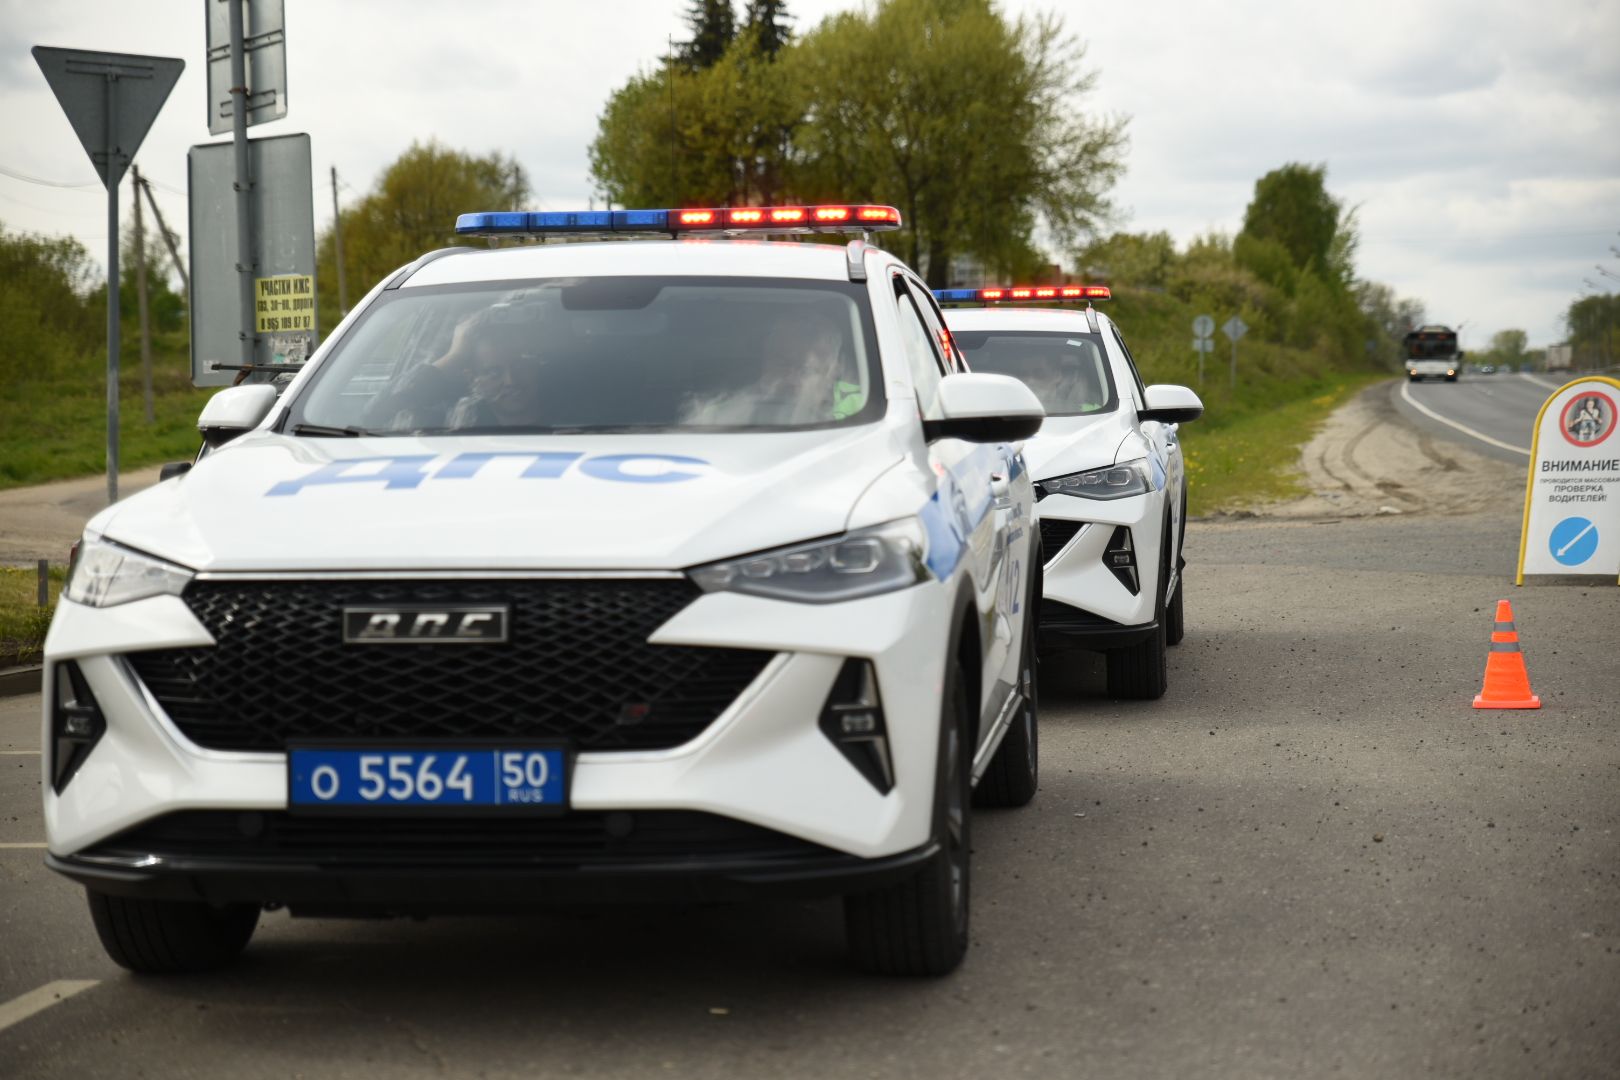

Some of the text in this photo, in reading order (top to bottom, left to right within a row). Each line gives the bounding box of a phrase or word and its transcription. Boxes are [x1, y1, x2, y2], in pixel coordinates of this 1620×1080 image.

[260, 278, 309, 296] УЧАСТКИ ИЖС
[264, 451, 711, 497] ДПС
[1542, 459, 1620, 472] ВНИМАНИЕ
[1548, 494, 1607, 502] ВОДИТЕЛЕЙ!
[357, 613, 493, 638] ДПС
[358, 756, 473, 800] 5564
[502, 752, 548, 788] 50
[508, 789, 543, 803] RUS
